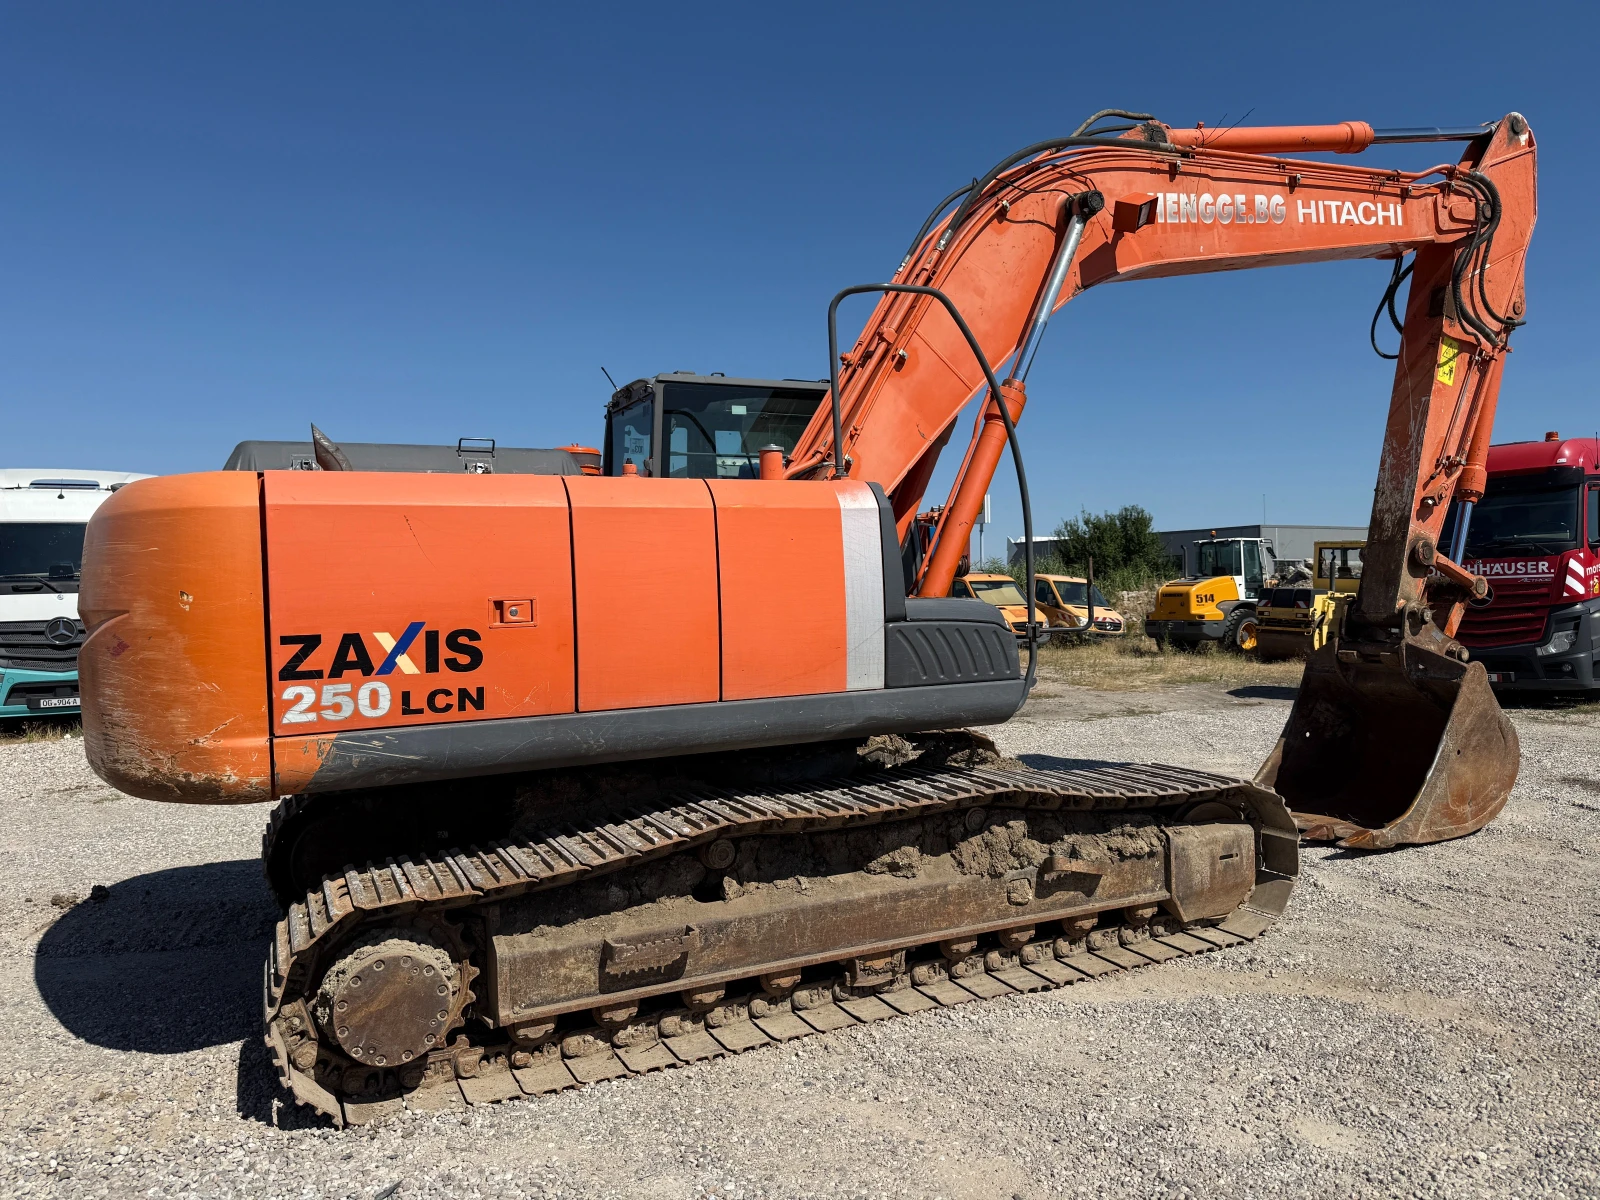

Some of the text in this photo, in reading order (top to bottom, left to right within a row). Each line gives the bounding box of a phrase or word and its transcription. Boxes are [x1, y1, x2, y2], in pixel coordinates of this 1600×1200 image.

[1297, 199, 1403, 226] HITACHI
[1196, 593, 1215, 603] 514
[278, 621, 484, 681] ZAXIS
[281, 681, 485, 724] 250 LCN
